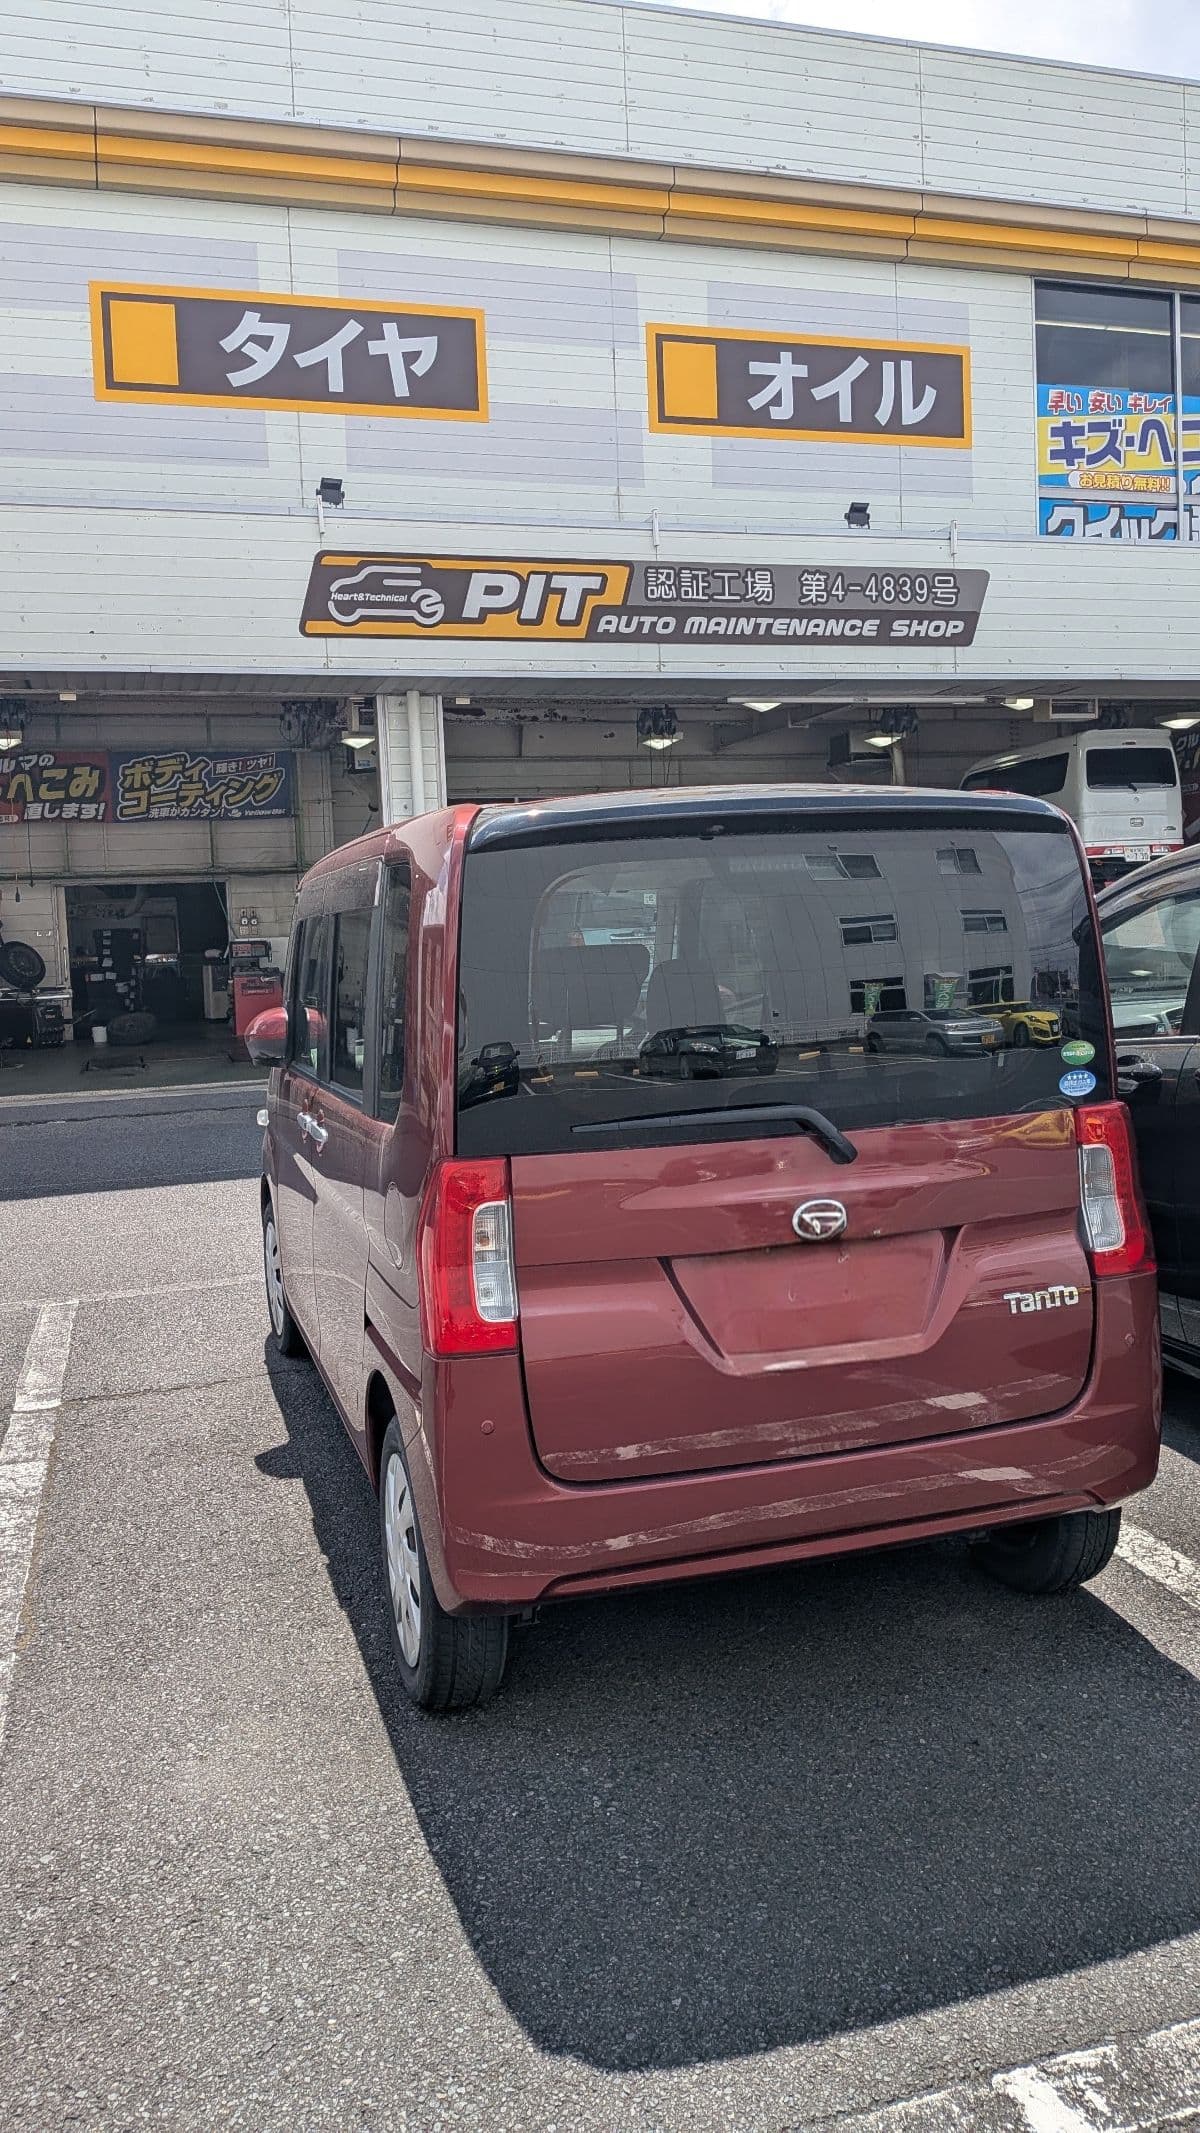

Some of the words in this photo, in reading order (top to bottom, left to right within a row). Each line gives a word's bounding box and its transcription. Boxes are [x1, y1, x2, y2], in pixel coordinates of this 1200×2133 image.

[219, 310, 438, 398] タイヤ
[747, 351, 937, 426] オイル
[1048, 390, 1082, 414] 早い
[1089, 391, 1122, 414] 安い
[1127, 393, 1173, 415] キレイ
[330, 591, 408, 603] Heart&Technical
[462, 571, 604, 621] PIT
[646, 568, 774, 603] 認証工場
[800, 570, 960, 606] 第4-4839号
[597, 615, 676, 635] AUTO
[683, 616, 879, 637] MAINTENANCE
[890, 619, 965, 639] SHOP
[123, 756, 207, 789] ボディ
[24, 802, 106, 820] 直します!
[122, 771, 282, 816] コーティング
